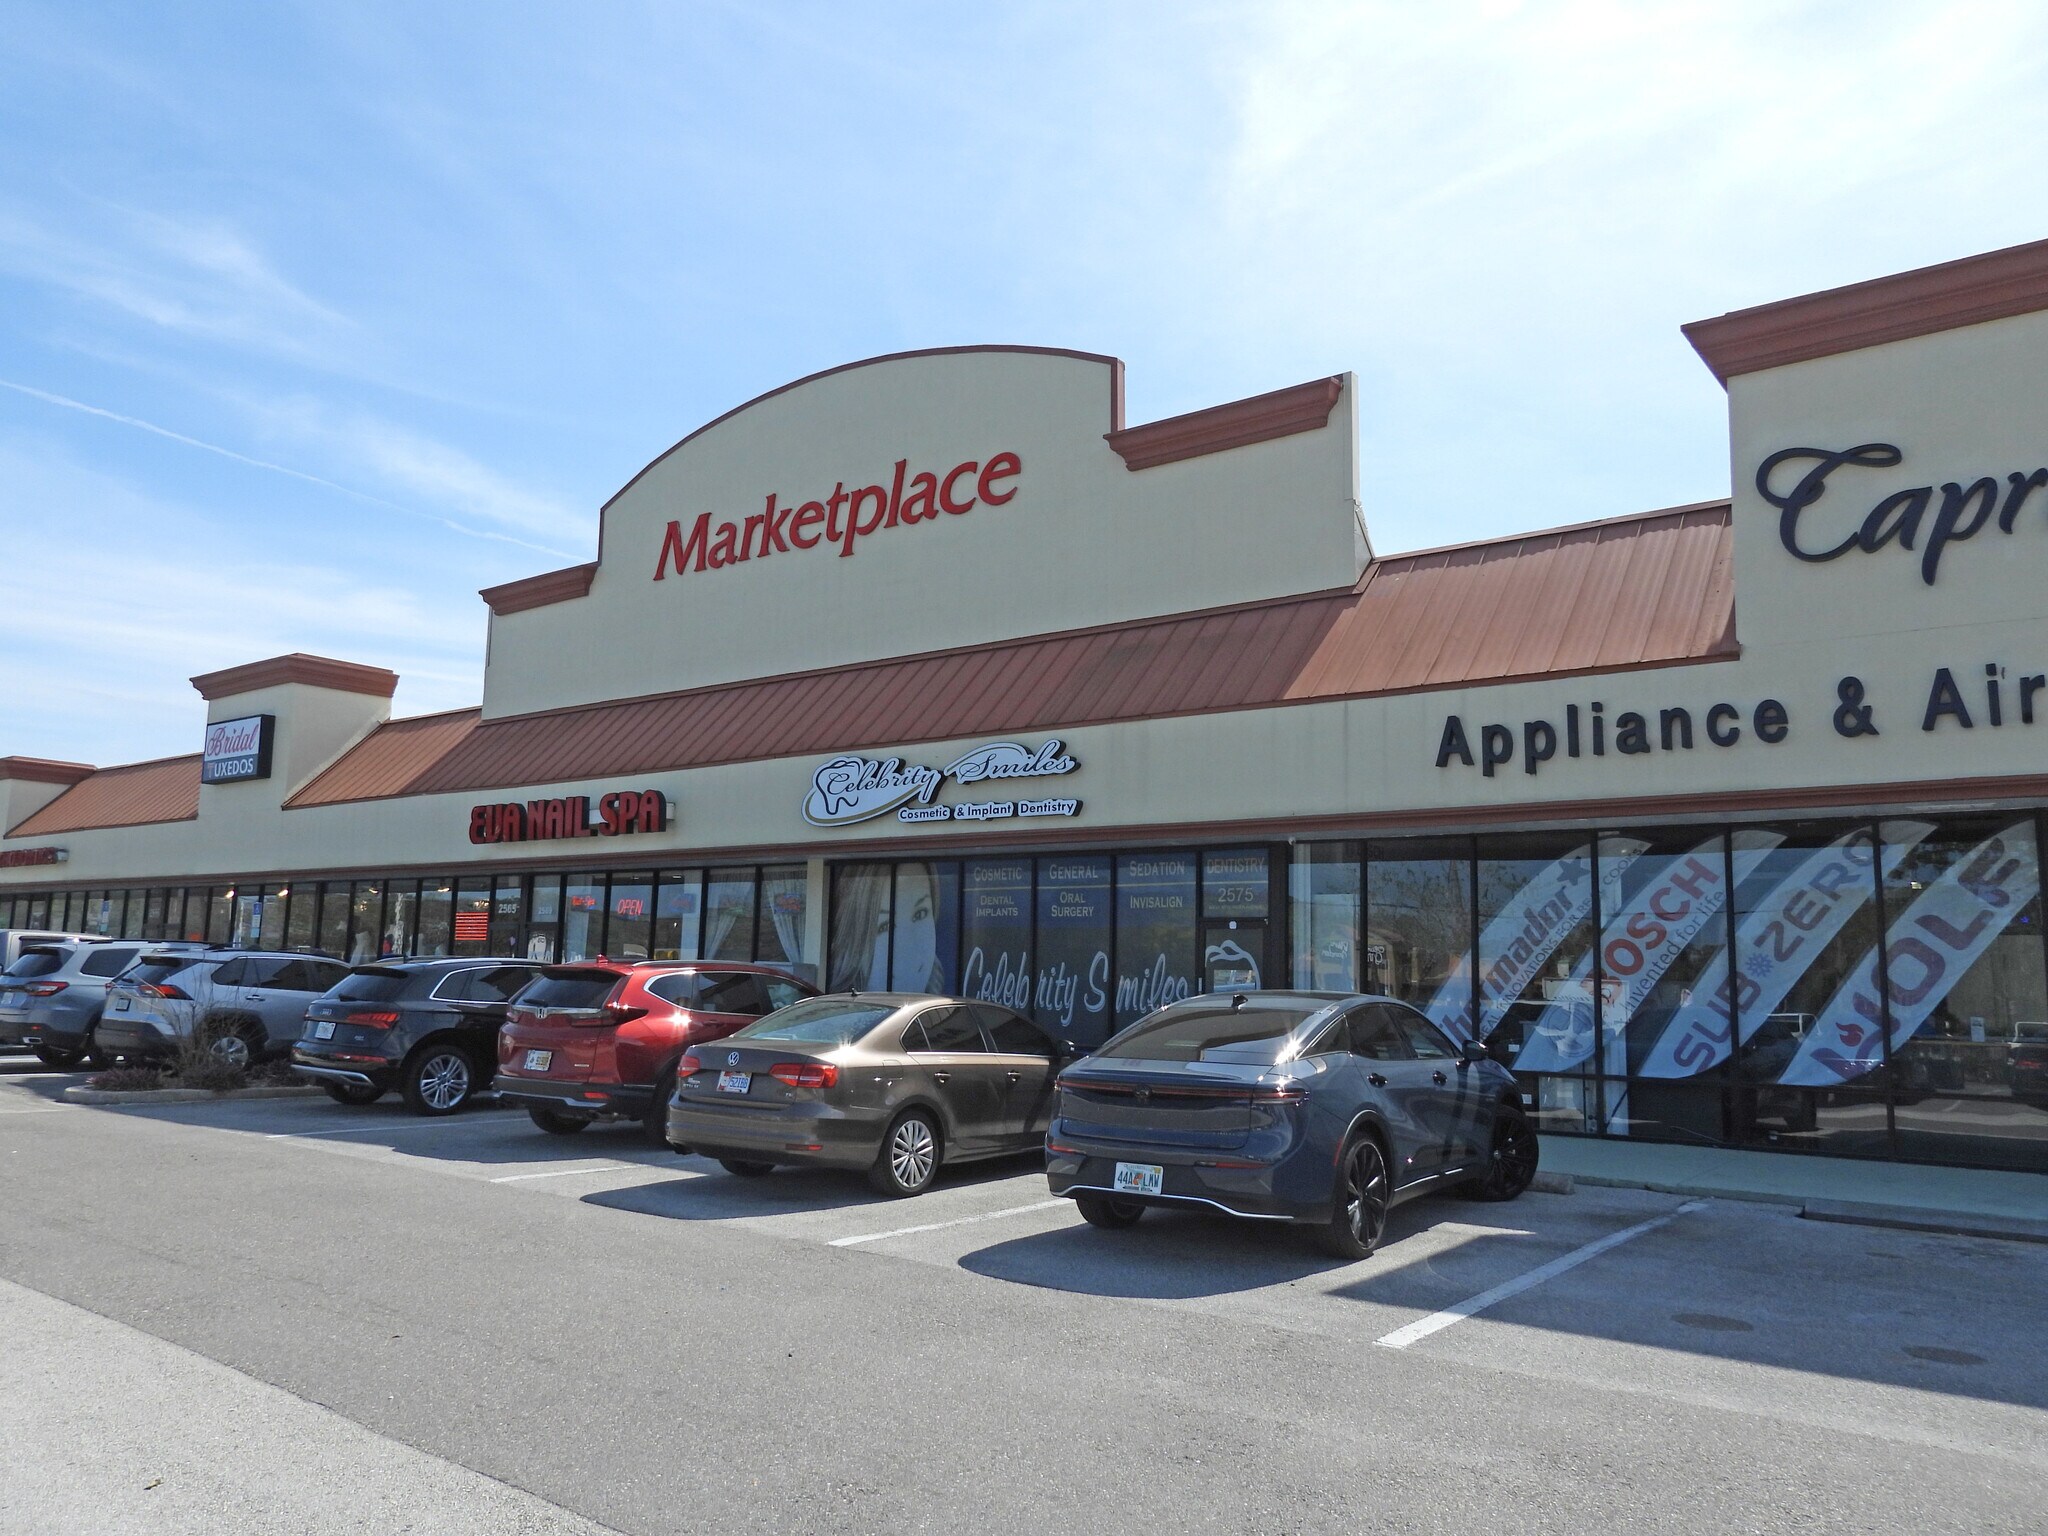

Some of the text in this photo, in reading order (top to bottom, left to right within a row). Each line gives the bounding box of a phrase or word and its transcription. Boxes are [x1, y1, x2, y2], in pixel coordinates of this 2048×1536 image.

[652, 451, 1022, 581] Marketplace
[1436, 663, 2047, 778] Appliance & Air
[206, 724, 259, 757] Bridal
[208, 758, 254, 778] TUXEDOS
[827, 741, 1069, 801] Celebrity Smiles
[469, 789, 666, 844] EVA NAIL SPA
[899, 801, 1076, 821] Cosmetic & Implant Dentistry
[1049, 864, 1099, 879] GENERAL
[1129, 861, 1185, 877] SEDATION
[1206, 857, 1265, 873] DENTISTRY
[1059, 891, 1086, 903] ORAL
[1129, 896, 1183, 908] INVISALIGN
[1218, 887, 1254, 902] 2575
[617, 899, 644, 915] OPEN
[1051, 906, 1094, 917] SURGERY
[1580, 856, 1720, 1006] BOSCH
[1673, 830, 1889, 1073] SUB ZERO
